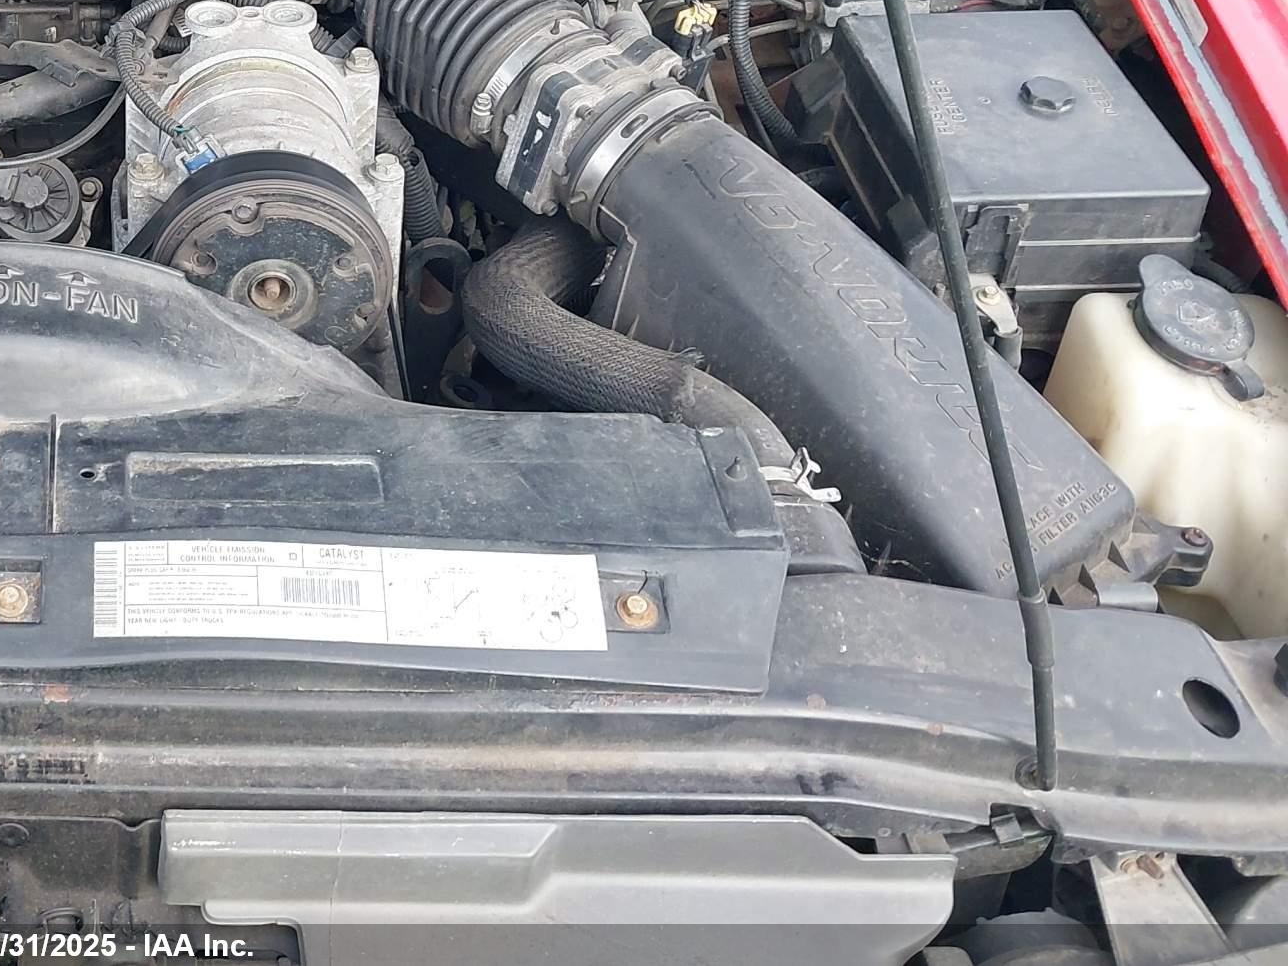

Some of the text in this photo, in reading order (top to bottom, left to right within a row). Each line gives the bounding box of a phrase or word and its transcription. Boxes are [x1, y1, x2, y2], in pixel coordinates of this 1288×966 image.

[1038, 512, 1077, 545] FILTER
[191, 545, 223, 553] VEHICLE
[319, 547, 365, 560] CATALYST
[180, 555, 216, 563] CONTROL
